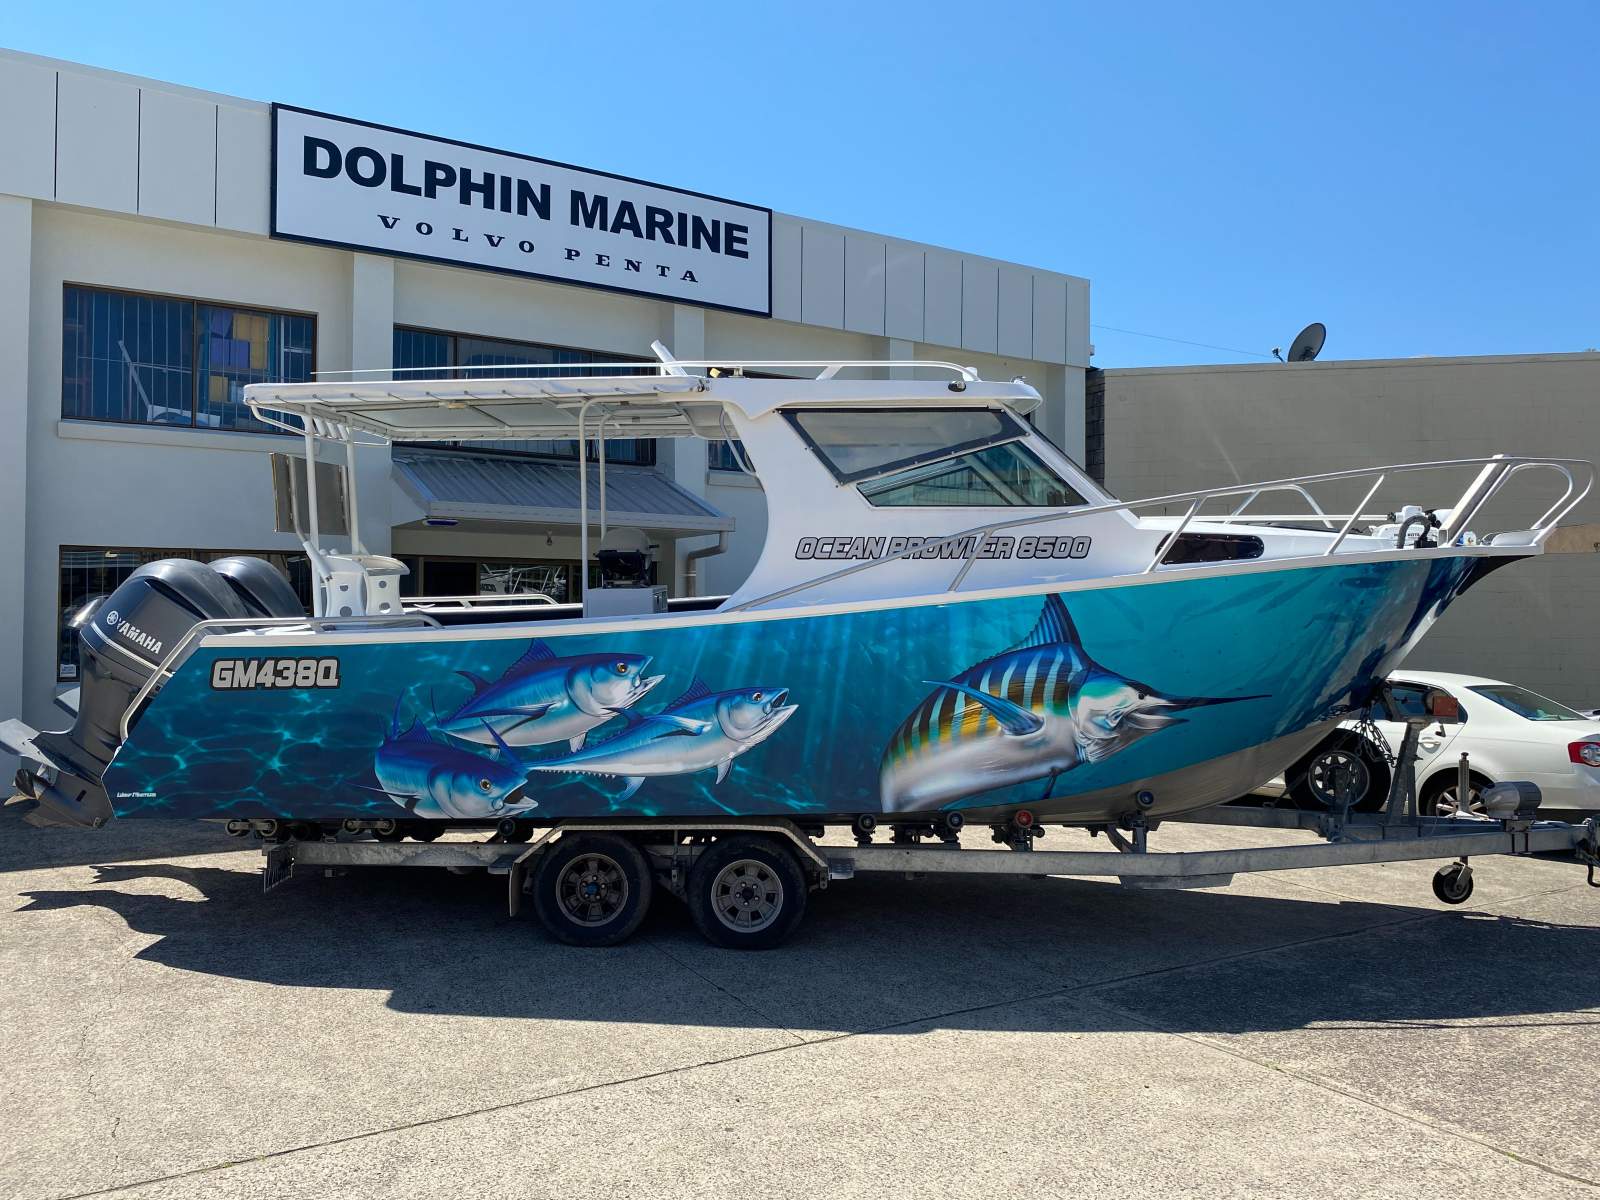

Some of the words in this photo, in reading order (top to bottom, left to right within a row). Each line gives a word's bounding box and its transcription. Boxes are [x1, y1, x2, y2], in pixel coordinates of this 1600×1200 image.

[303, 135, 551, 221] DOLPHIN
[570, 189, 749, 260] MARINE
[378, 214, 535, 255] VOLVO
[564, 247, 699, 284] PENTA
[795, 536, 887, 560] OCEAN
[1016, 536, 1092, 559] 8500
[116, 617, 163, 655] YAMAHA
[210, 657, 341, 690] GM438Q
